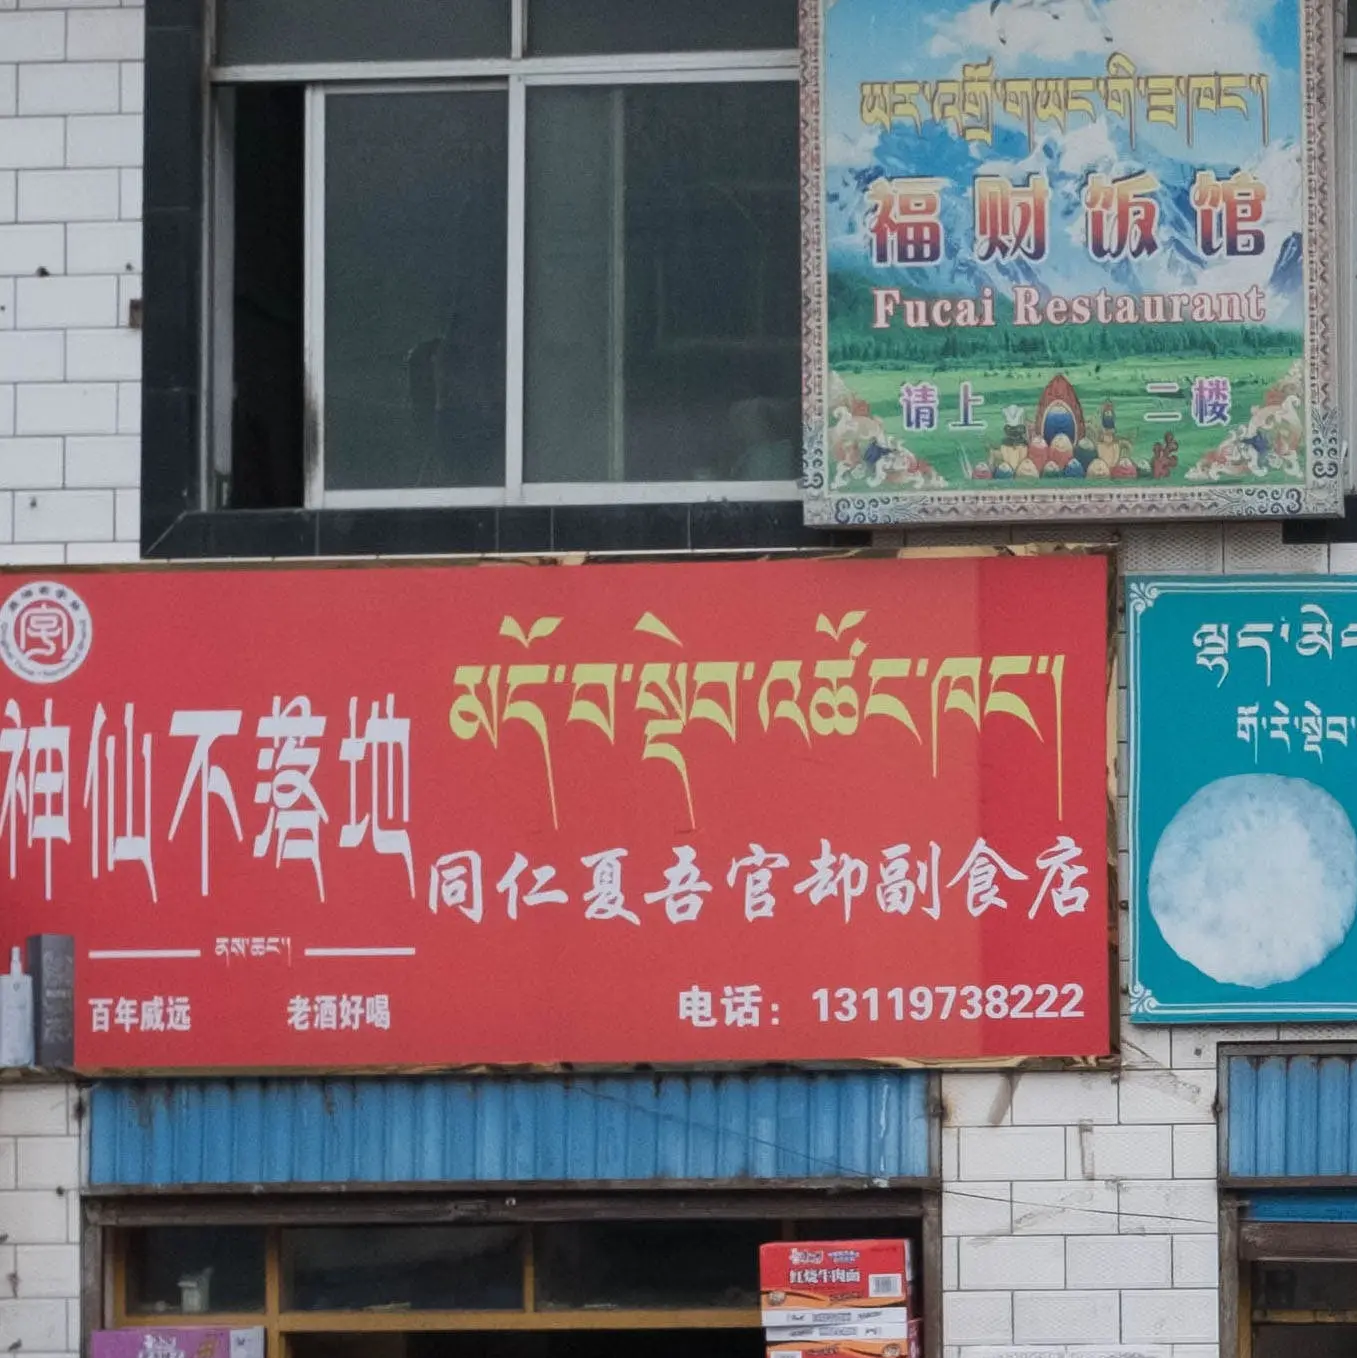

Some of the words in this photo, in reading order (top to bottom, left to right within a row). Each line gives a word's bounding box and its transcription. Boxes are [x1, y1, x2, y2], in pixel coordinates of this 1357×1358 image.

[866, 170, 1269, 267] 福财饭馆
[871, 287, 997, 328] Fucai
[1012, 284, 1267, 326] Restaurant
[899, 382, 987, 431] 请上
[1145, 377, 1232, 427] 二楼
[0, 694, 416, 902] 神仙不落地
[429, 836, 1090, 927] 同仁夏吾官却副食店
[89, 996, 191, 1033] 百年威远
[287, 994, 391, 1031] 老酒好喝
[812, 983, 1085, 1022] 13119738222
